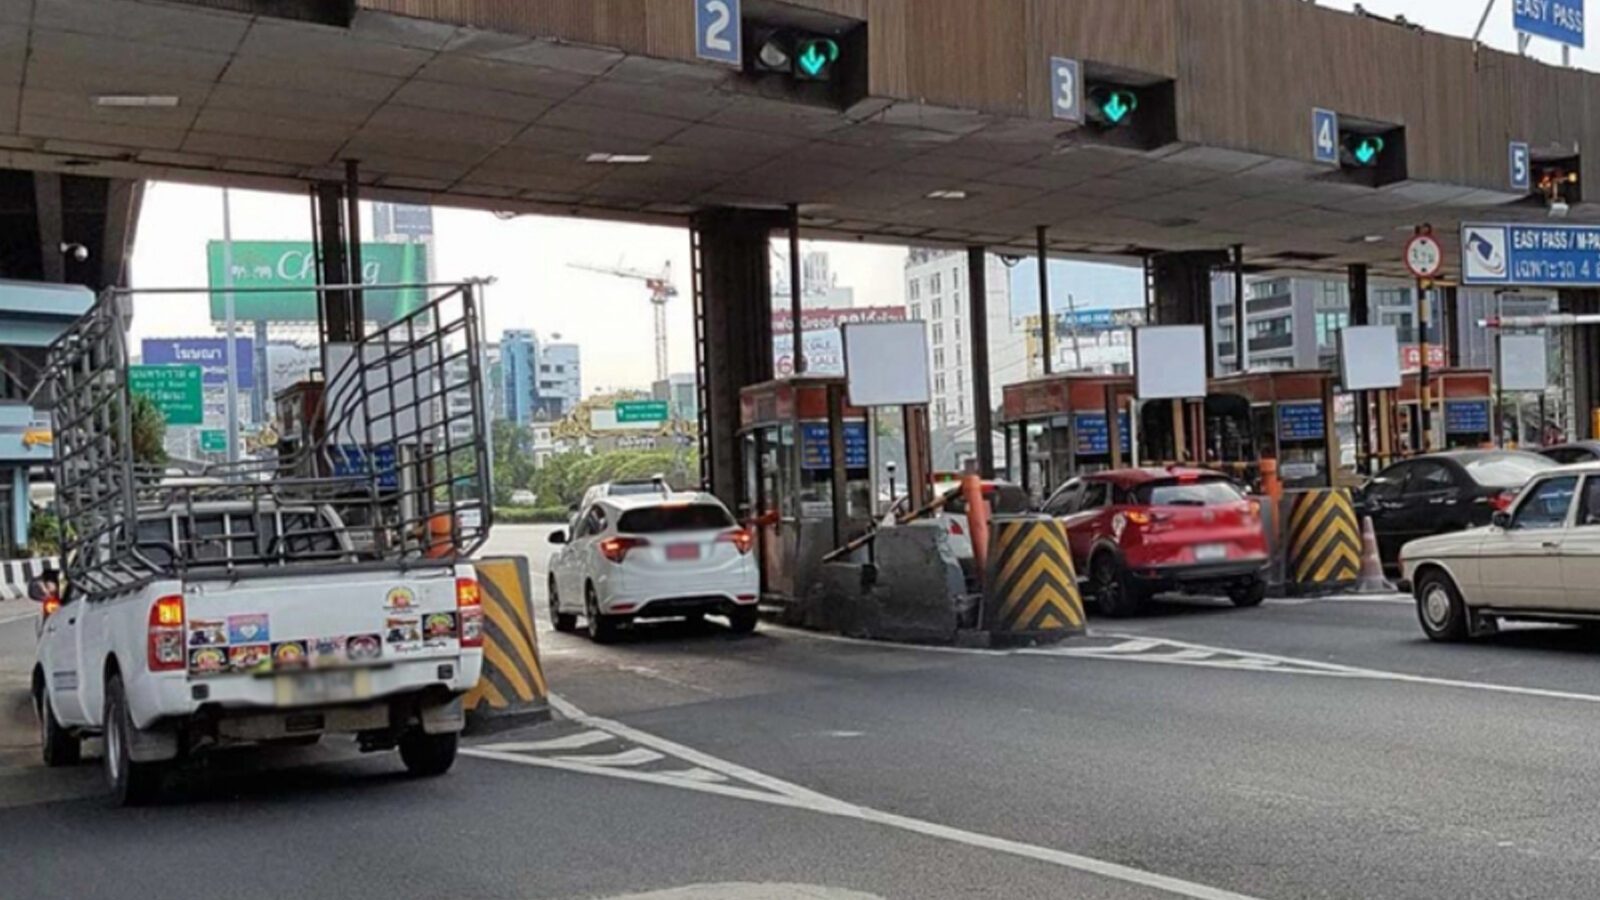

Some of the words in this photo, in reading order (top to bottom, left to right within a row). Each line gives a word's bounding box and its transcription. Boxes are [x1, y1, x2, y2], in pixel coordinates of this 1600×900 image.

[705, 0, 731, 51] 2
[1516, 0, 1549, 21] EASY
[1553, 3, 1582, 33] PASS
[1057, 67, 1072, 109] 3
[1318, 118, 1332, 154] 4
[1514, 149, 1525, 181] 5
[1513, 229, 1540, 249] EASY
[1542, 230, 1568, 250] PASS
[277, 250, 382, 285] Chg
[1515, 260, 1576, 278] เฉพาะรถ
[1580, 259, 1591, 278] 4
